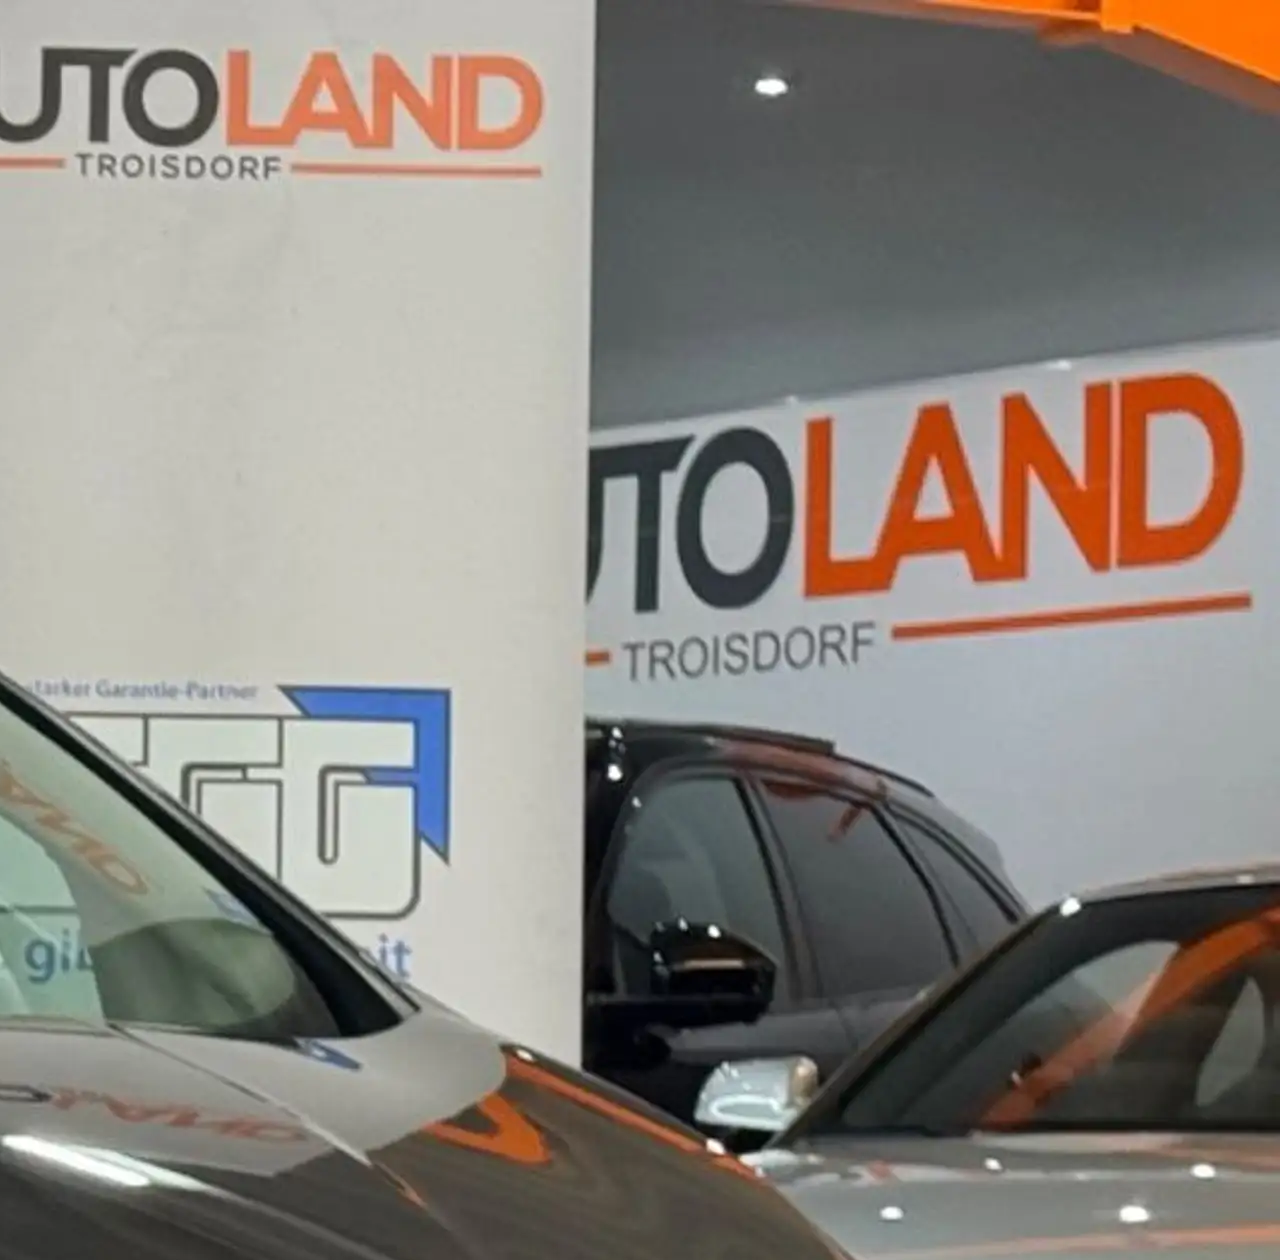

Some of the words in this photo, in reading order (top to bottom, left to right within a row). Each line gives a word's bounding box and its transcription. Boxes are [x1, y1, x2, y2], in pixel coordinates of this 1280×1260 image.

[75, 153, 282, 181] TROISDORF
[586, 372, 1244, 613] TOLAND
[623, 621, 876, 682] TROISDORF
[95, 678, 259, 700] Garantie-Partner
